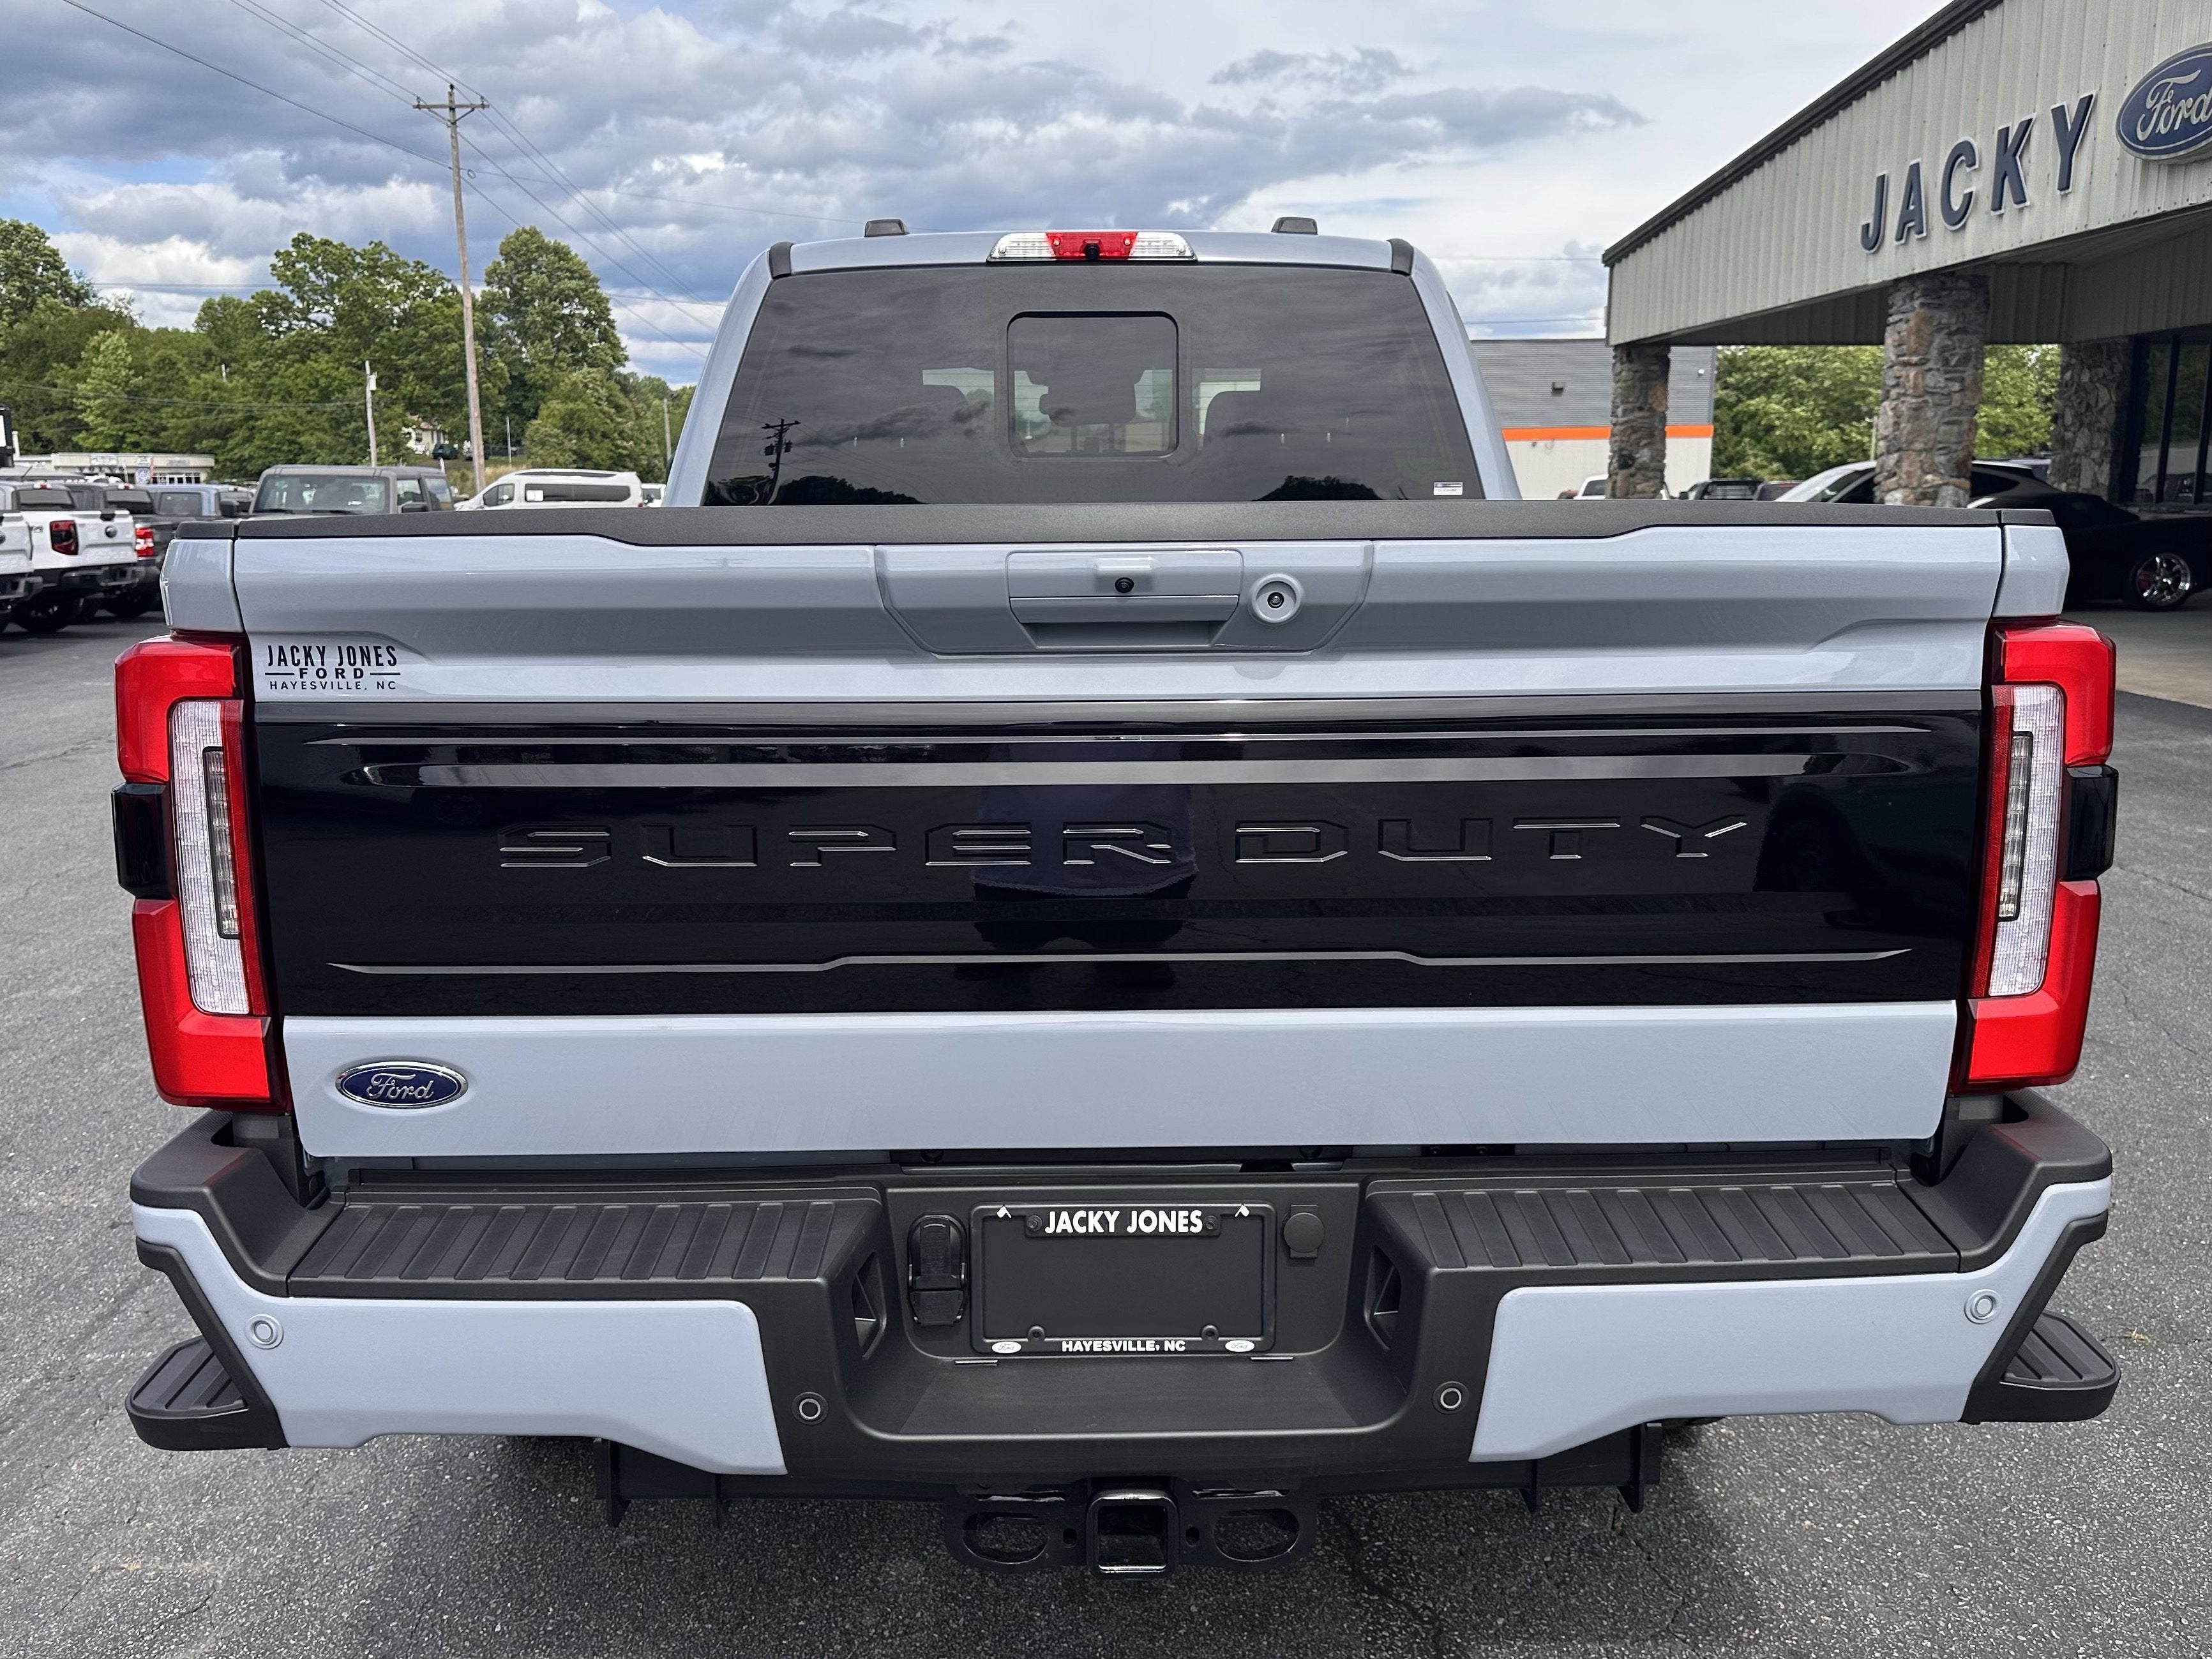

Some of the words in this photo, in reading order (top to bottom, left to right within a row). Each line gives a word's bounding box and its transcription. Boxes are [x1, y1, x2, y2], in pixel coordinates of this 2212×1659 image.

[2137, 69, 2212, 141] Ford
[1860, 91, 2098, 255] JACKY
[268, 645, 326, 666] JACKY
[337, 645, 397, 666] JONES
[269, 680, 367, 691] HAYESVILLE,
[377, 680, 396, 690] NC
[299, 668, 364, 679] FORD
[498, 822, 1172, 867] SUPER
[1235, 814, 1748, 863] DUTY
[366, 1072, 434, 1100] Ford
[1044, 1210, 1120, 1234] JACKY
[1126, 1210, 1203, 1233] JONES
[1062, 1340, 1160, 1351] HAYESVILLE,
[1164, 1340, 1186, 1351] NC
